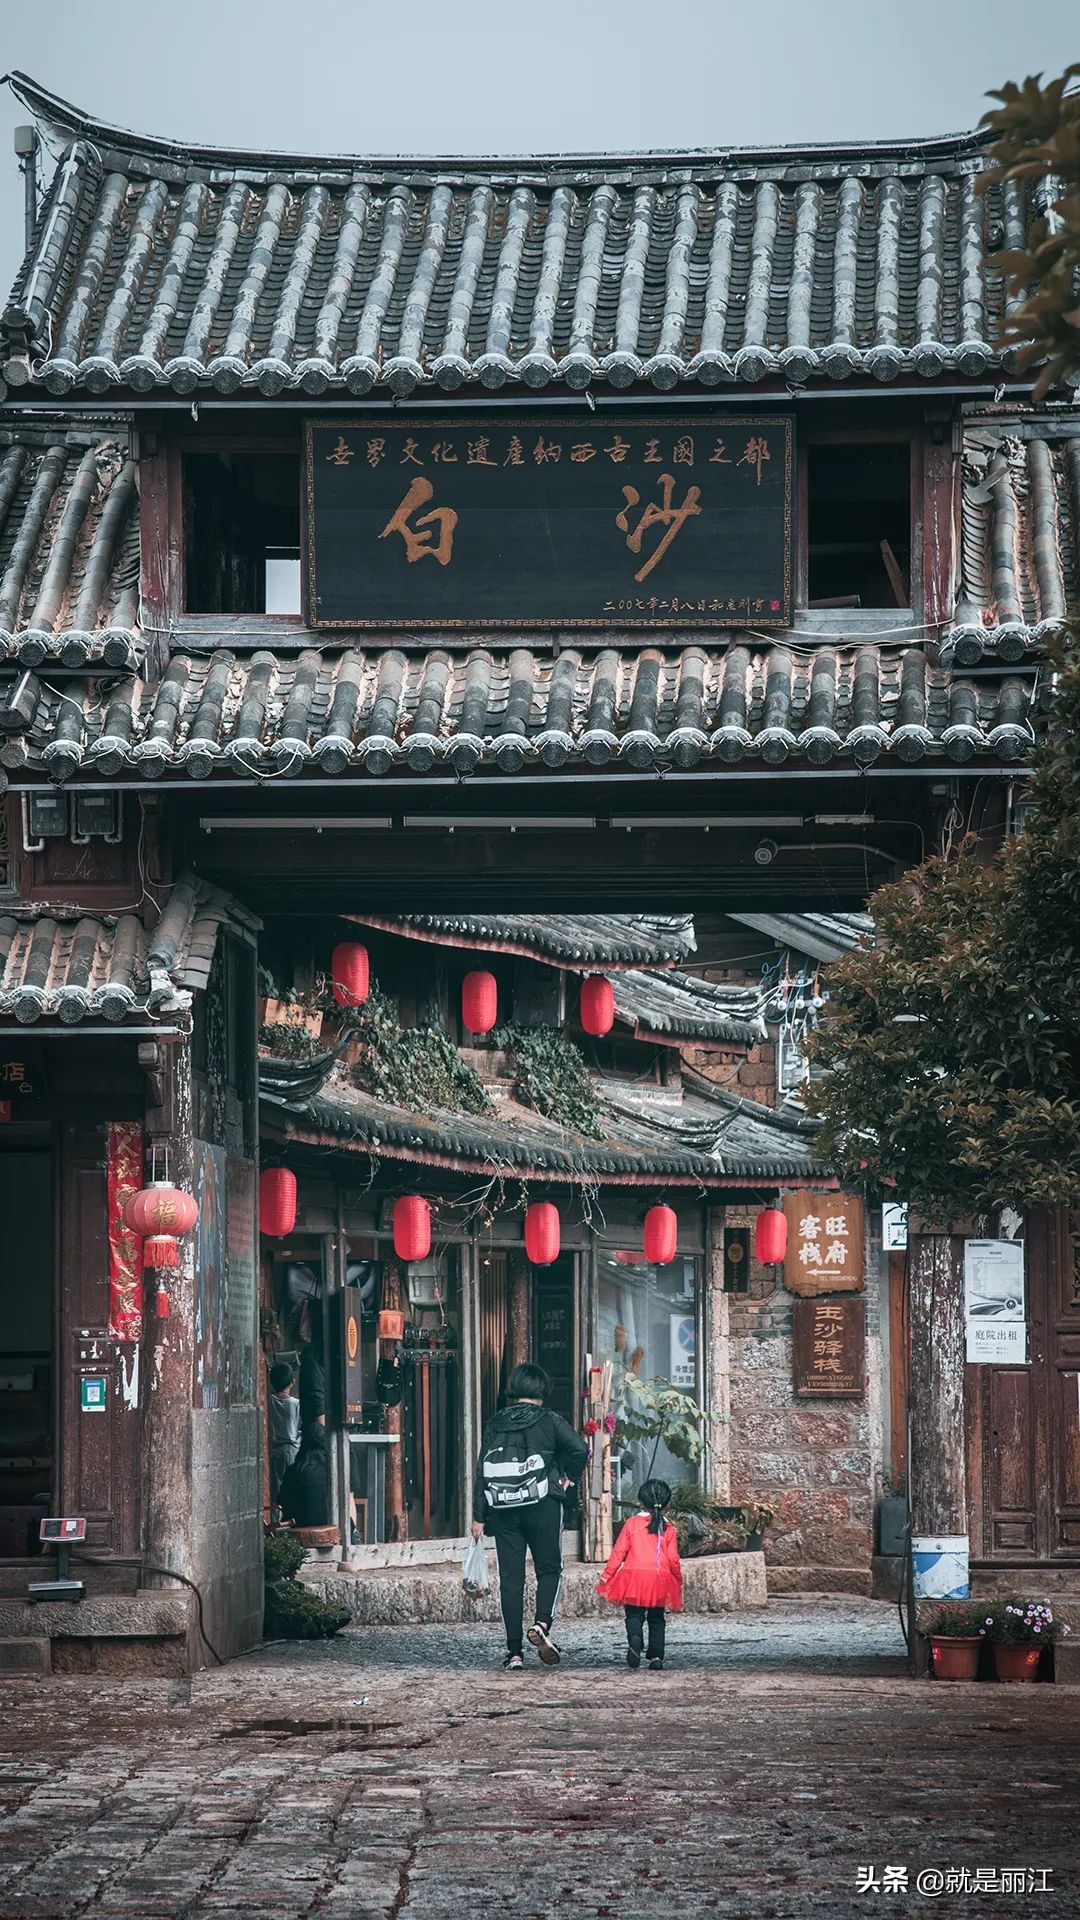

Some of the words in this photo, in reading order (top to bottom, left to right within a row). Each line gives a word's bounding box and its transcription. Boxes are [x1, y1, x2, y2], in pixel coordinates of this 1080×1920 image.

[152, 1199, 179, 1225] 福
[975, 1329, 1018, 1341] 庭院出租
